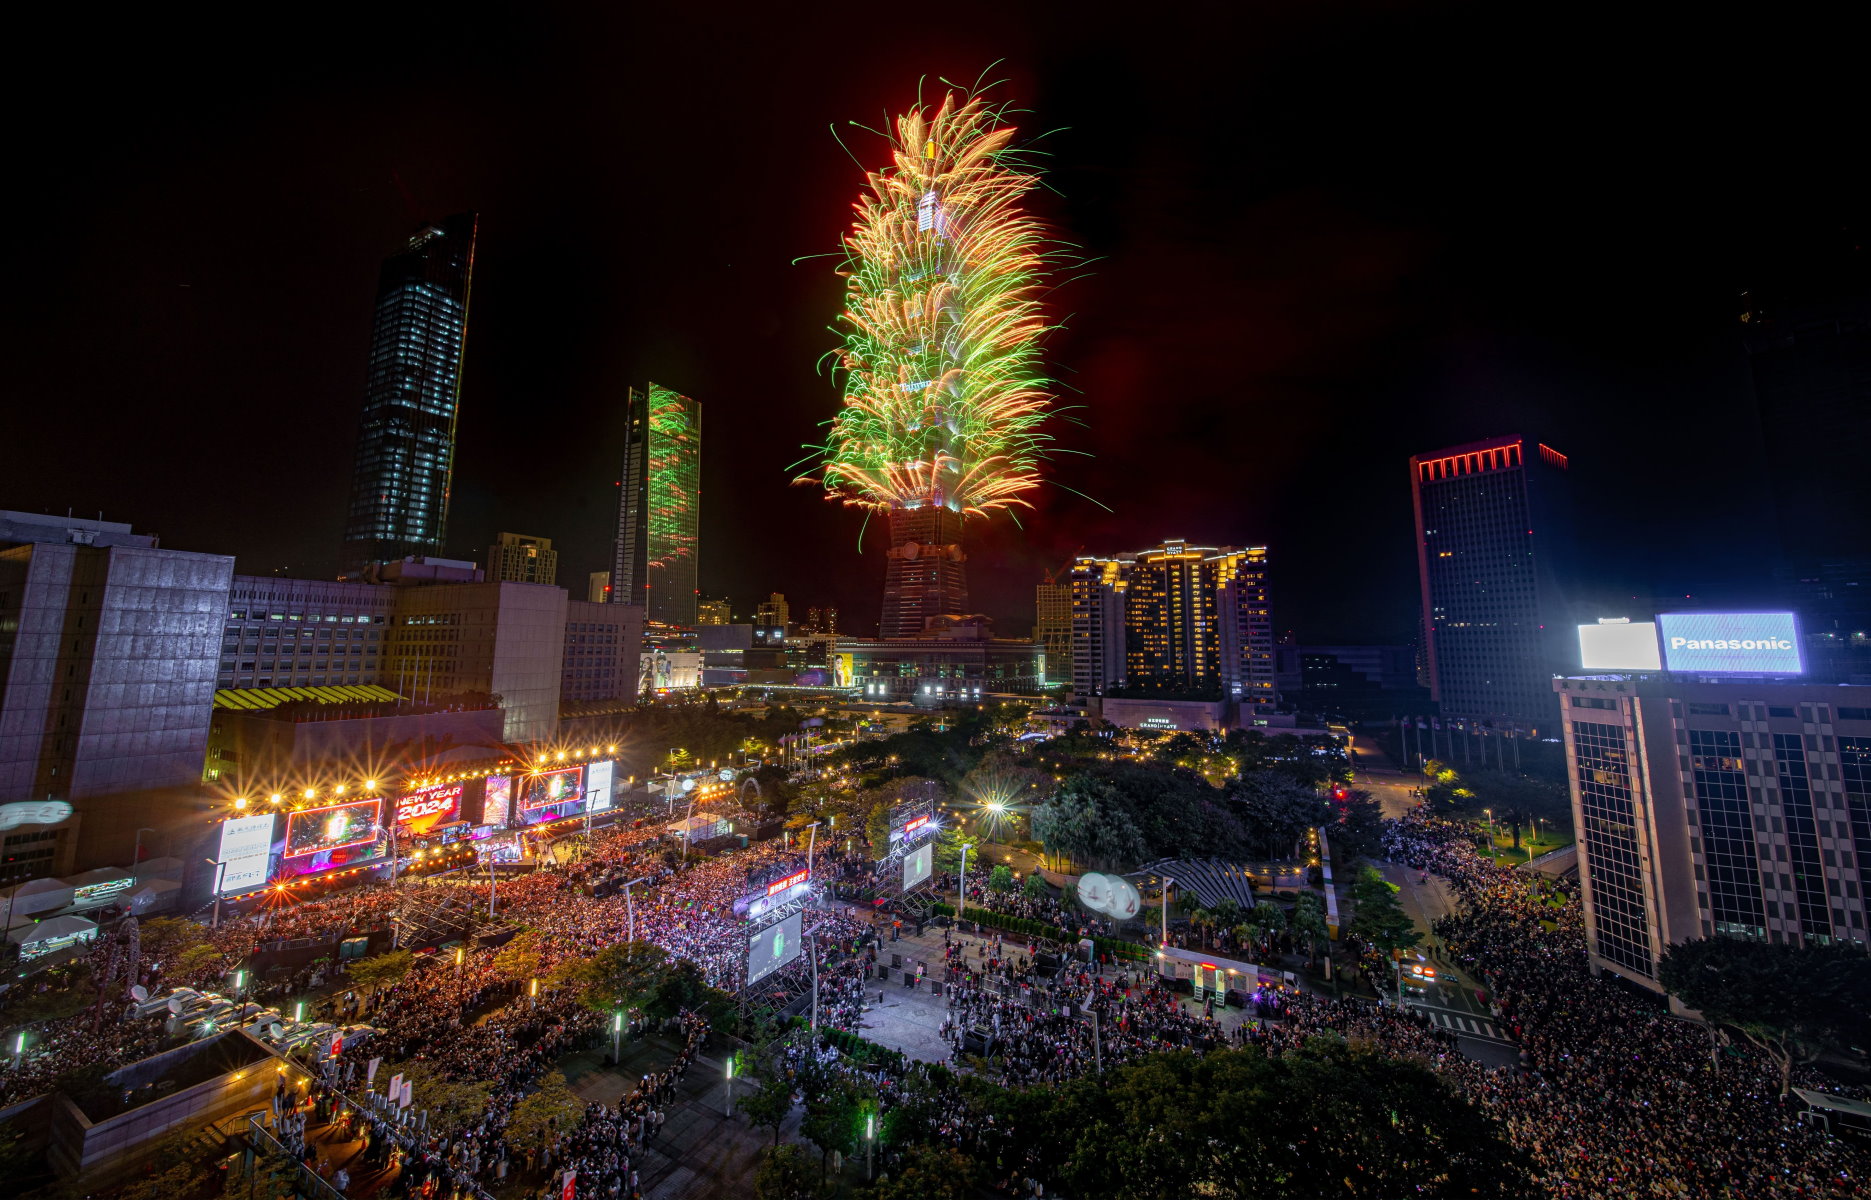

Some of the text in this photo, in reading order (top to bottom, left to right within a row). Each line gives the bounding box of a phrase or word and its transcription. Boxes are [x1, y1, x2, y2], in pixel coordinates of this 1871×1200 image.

[1670, 636, 1792, 650] Panasonic
[396, 787, 461, 807] NEW YEAR
[416, 783, 444, 794] HAPPY
[398, 796, 454, 820] 2024
